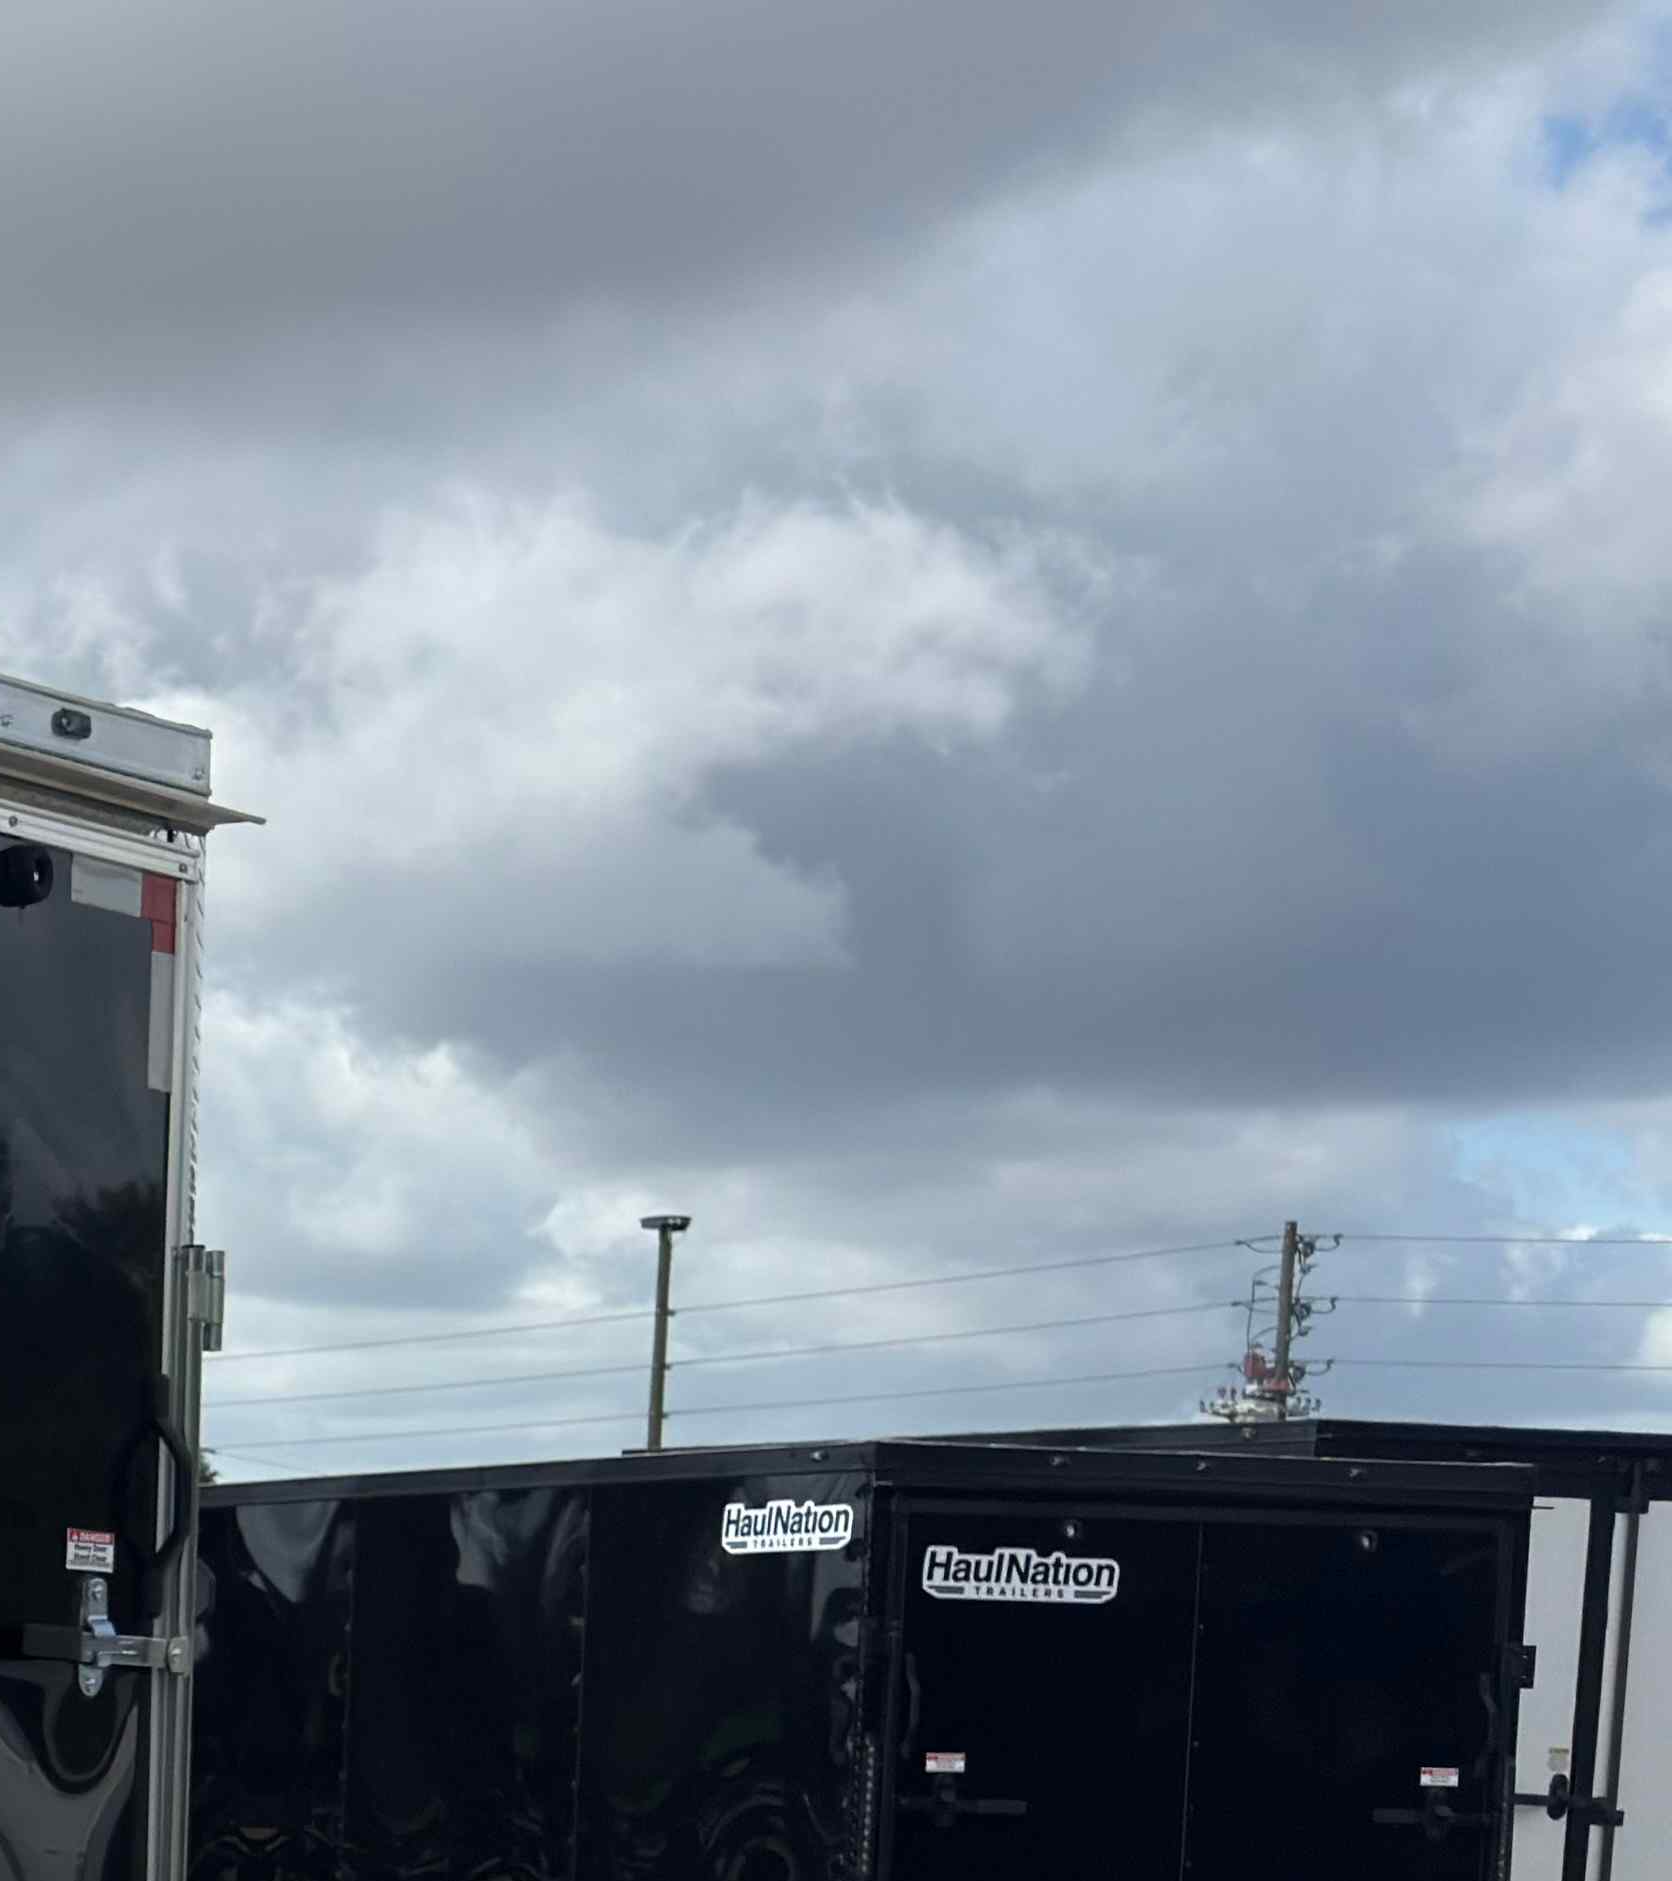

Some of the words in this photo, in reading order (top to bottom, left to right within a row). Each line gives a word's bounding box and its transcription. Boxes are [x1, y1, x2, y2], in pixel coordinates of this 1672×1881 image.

[725, 1505, 850, 1537] HaulNation
[927, 1551, 1116, 1587] HaulNation
[975, 1586, 1064, 1599] TRAILERS
